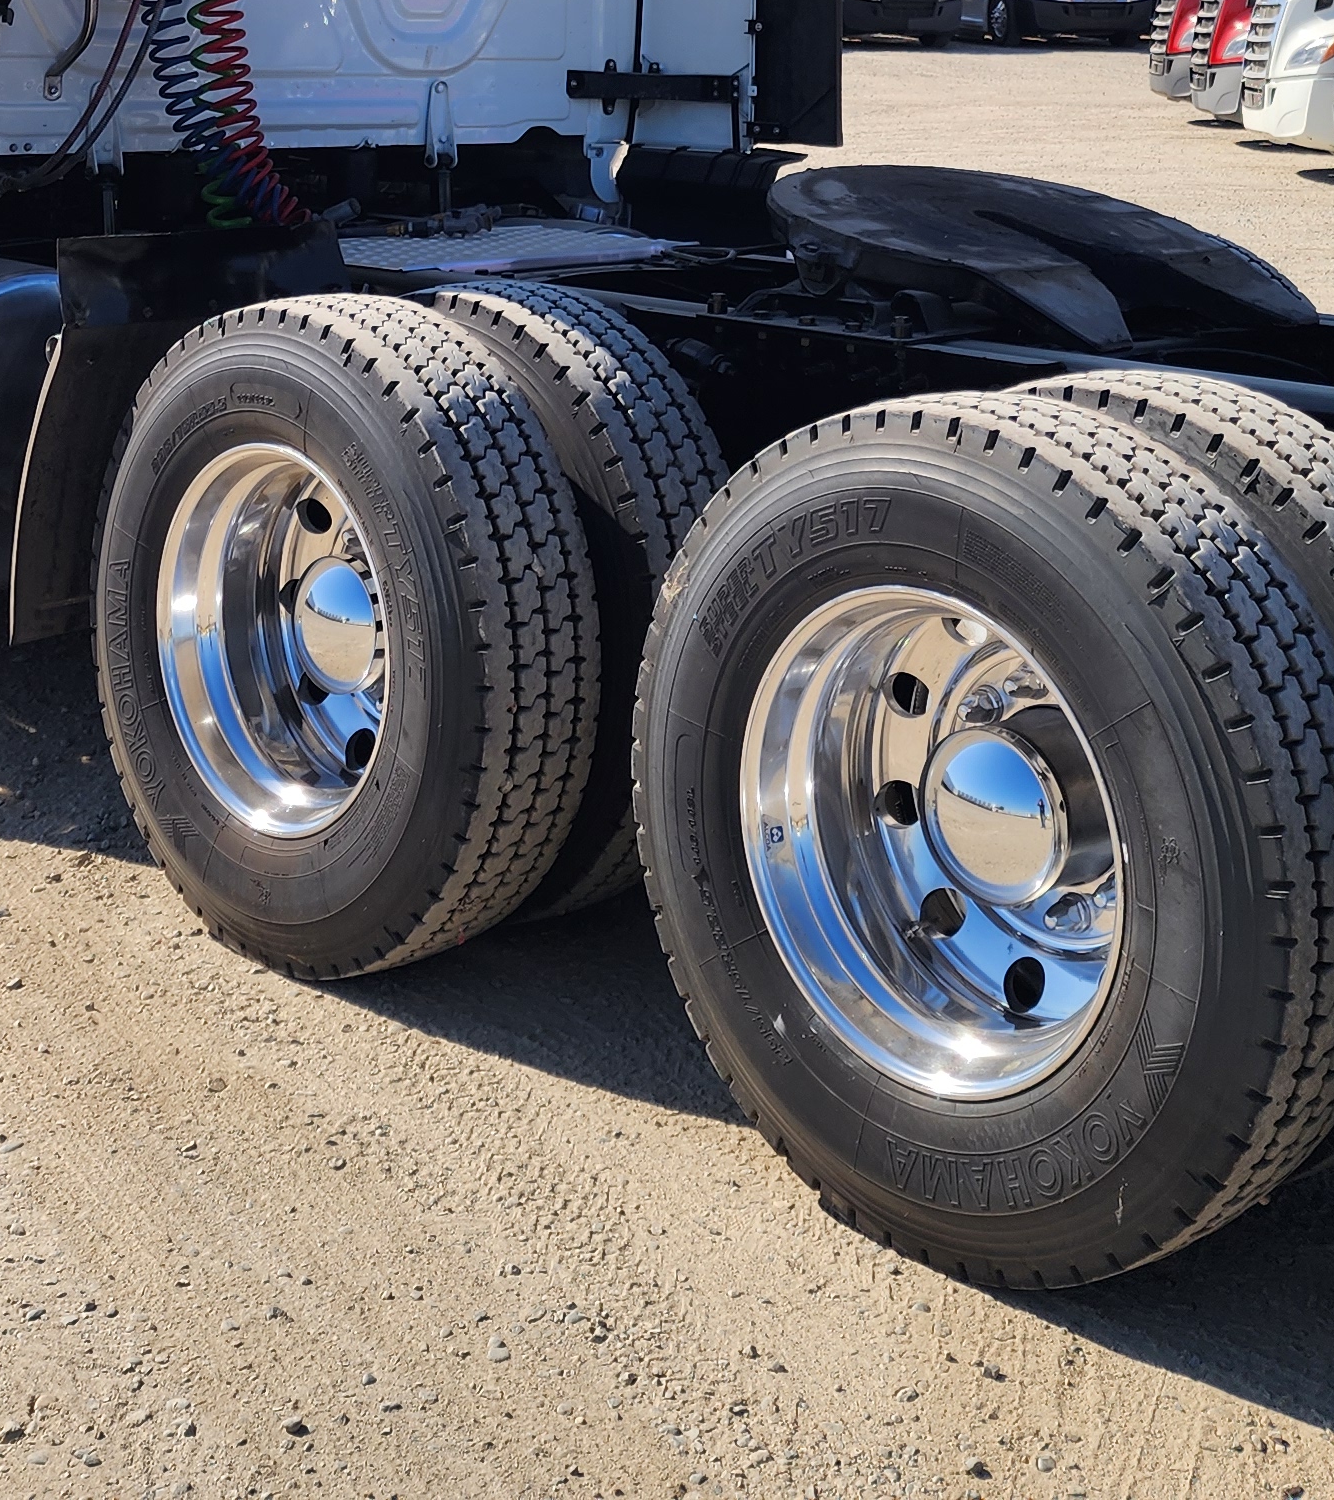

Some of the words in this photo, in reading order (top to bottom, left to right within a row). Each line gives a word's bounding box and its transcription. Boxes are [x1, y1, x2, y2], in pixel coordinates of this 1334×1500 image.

[752, 497, 892, 580] TY517
[698, 555, 756, 636] SUPER
[703, 579, 761, 658] STEEL
[107, 558, 165, 812] YOKOHAMA
[885, 1088, 1146, 1210] YOKOHAMA
